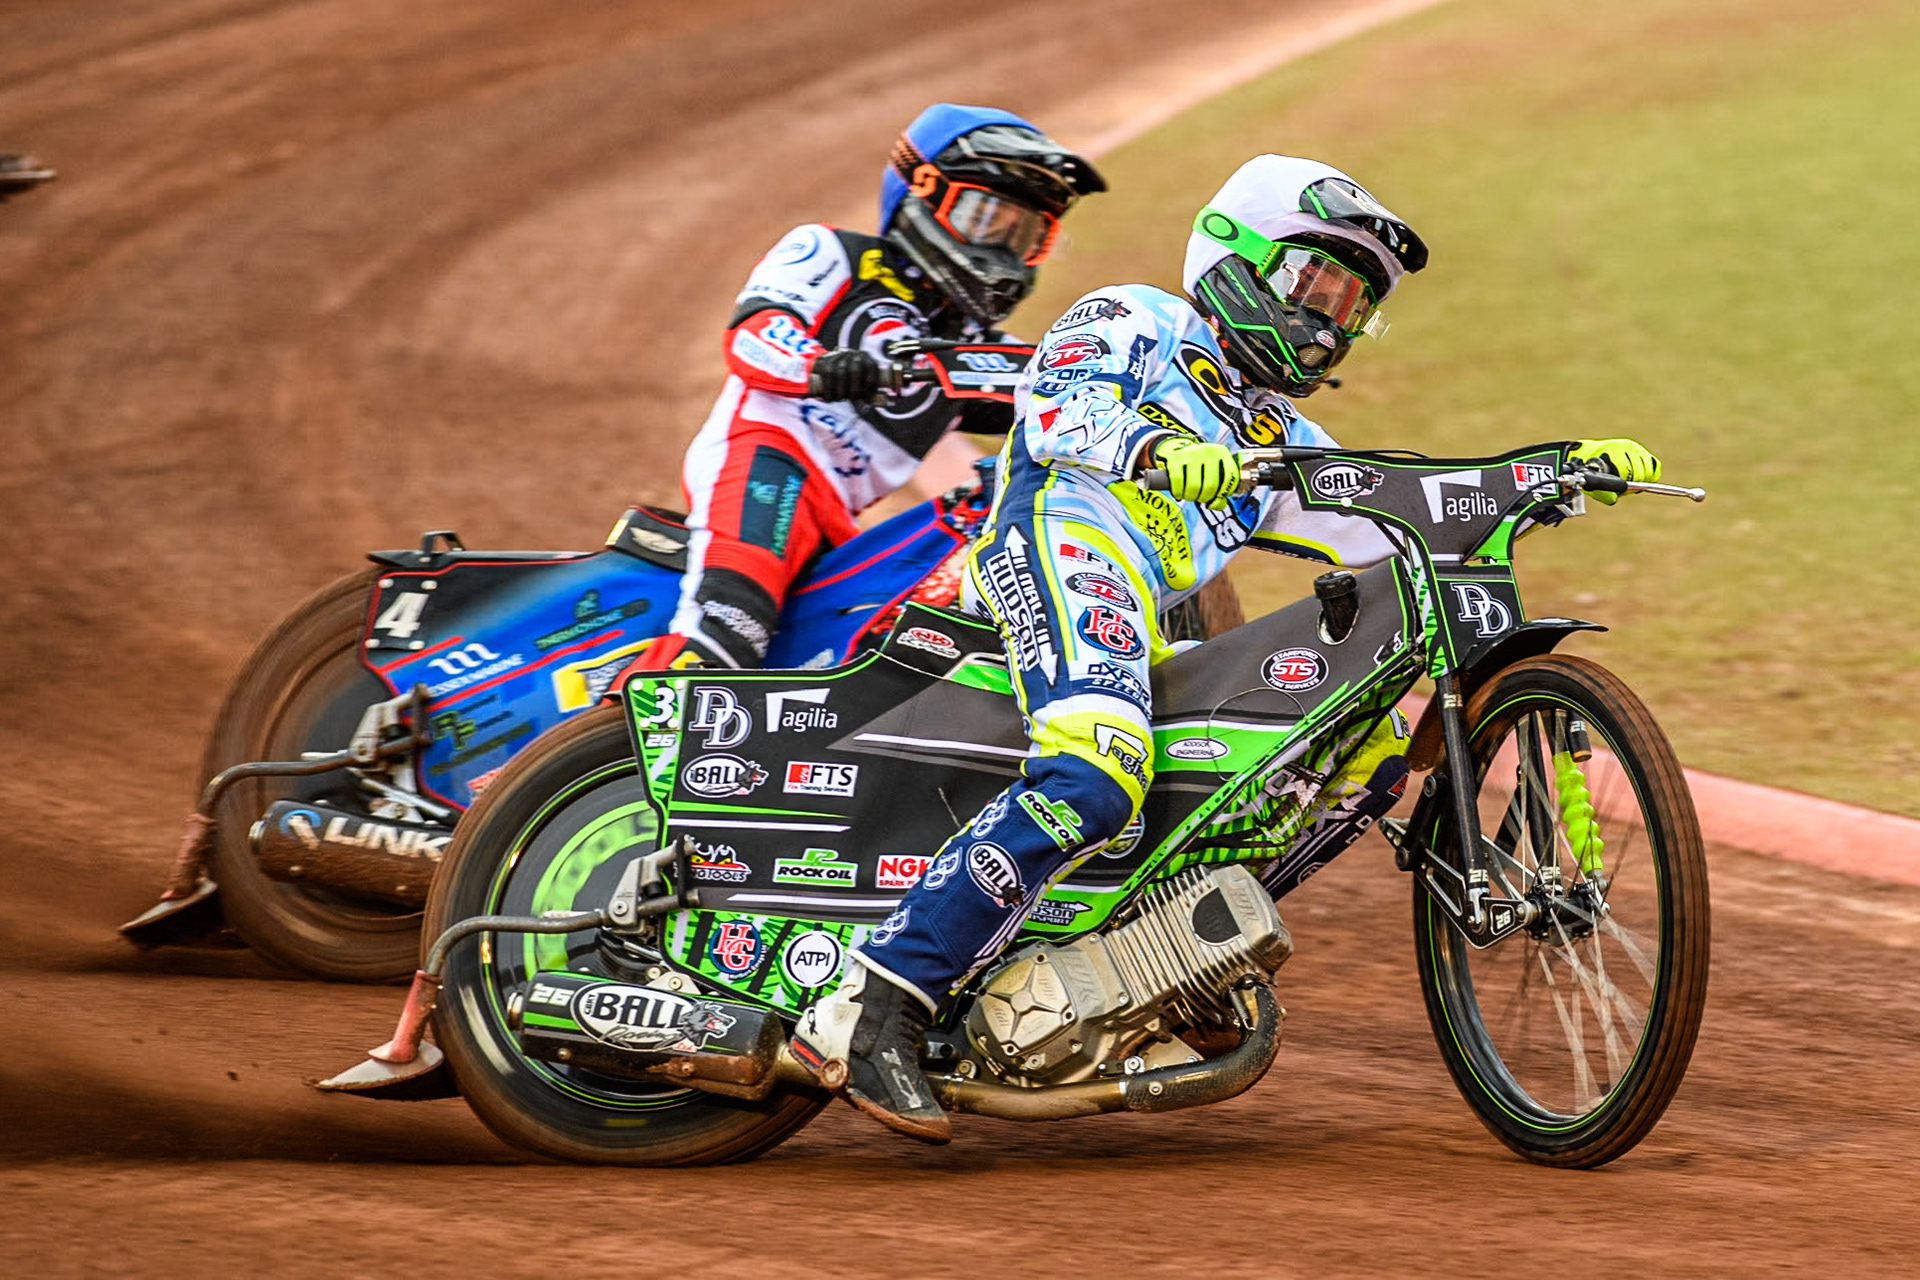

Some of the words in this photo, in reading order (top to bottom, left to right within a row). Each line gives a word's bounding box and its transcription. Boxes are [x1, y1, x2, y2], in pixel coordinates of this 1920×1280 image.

[1322, 470, 1362, 489] BALL
[1446, 492, 1498, 522] agilia
[374, 592, 429, 638] 4
[989, 554, 1038, 668] HUDSON
[1272, 661, 1316, 676] STS
[648, 686, 676, 724] 3
[782, 707, 838, 732] agilia
[645, 733, 677, 747] 26
[694, 765, 740, 785] BALL
[809, 765, 853, 786] FTS
[1024, 793, 1061, 829] ROCK
[778, 866, 823, 878] ROCK
[826, 869, 852, 880] OIL
[1495, 909, 1511, 930] 26
[794, 950, 831, 967] ATPI
[592, 991, 686, 1029] BALL
